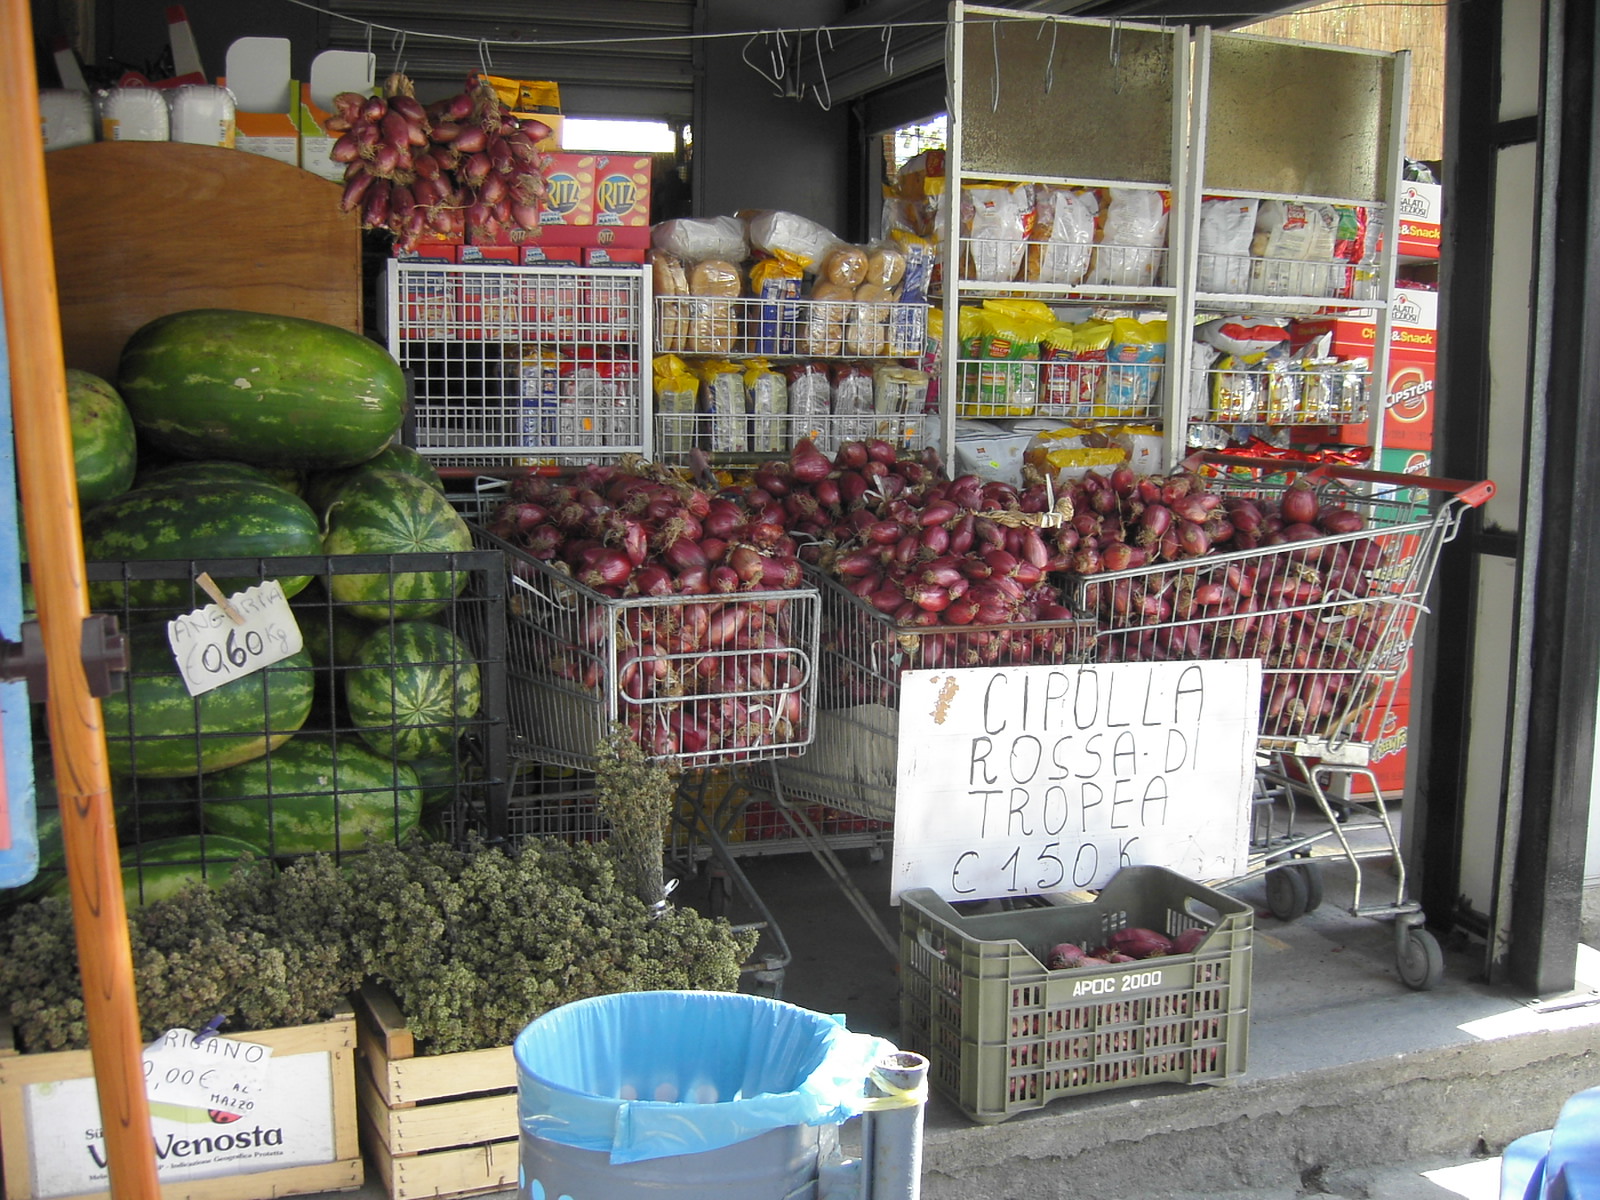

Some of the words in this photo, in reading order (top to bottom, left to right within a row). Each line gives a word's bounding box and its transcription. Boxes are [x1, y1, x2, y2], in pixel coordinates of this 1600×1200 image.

[599, 181, 635, 209] RITZ
[1400, 205, 1426, 216] REZIOSI
[599, 231, 613, 243] RITZ
[1392, 304, 1415, 314] ALATI
[264, 623, 289, 655] Kg
[983, 664, 1205, 736] CIPOLLA
[967, 775, 1169, 839] TROPEA
[1072, 977, 1116, 998] APOC
[1120, 970, 1163, 993] 2000
[152, 1125, 284, 1160] Venosta
[213, 1152, 253, 1163] Geografica
[253, 1150, 284, 1159] Protetta
